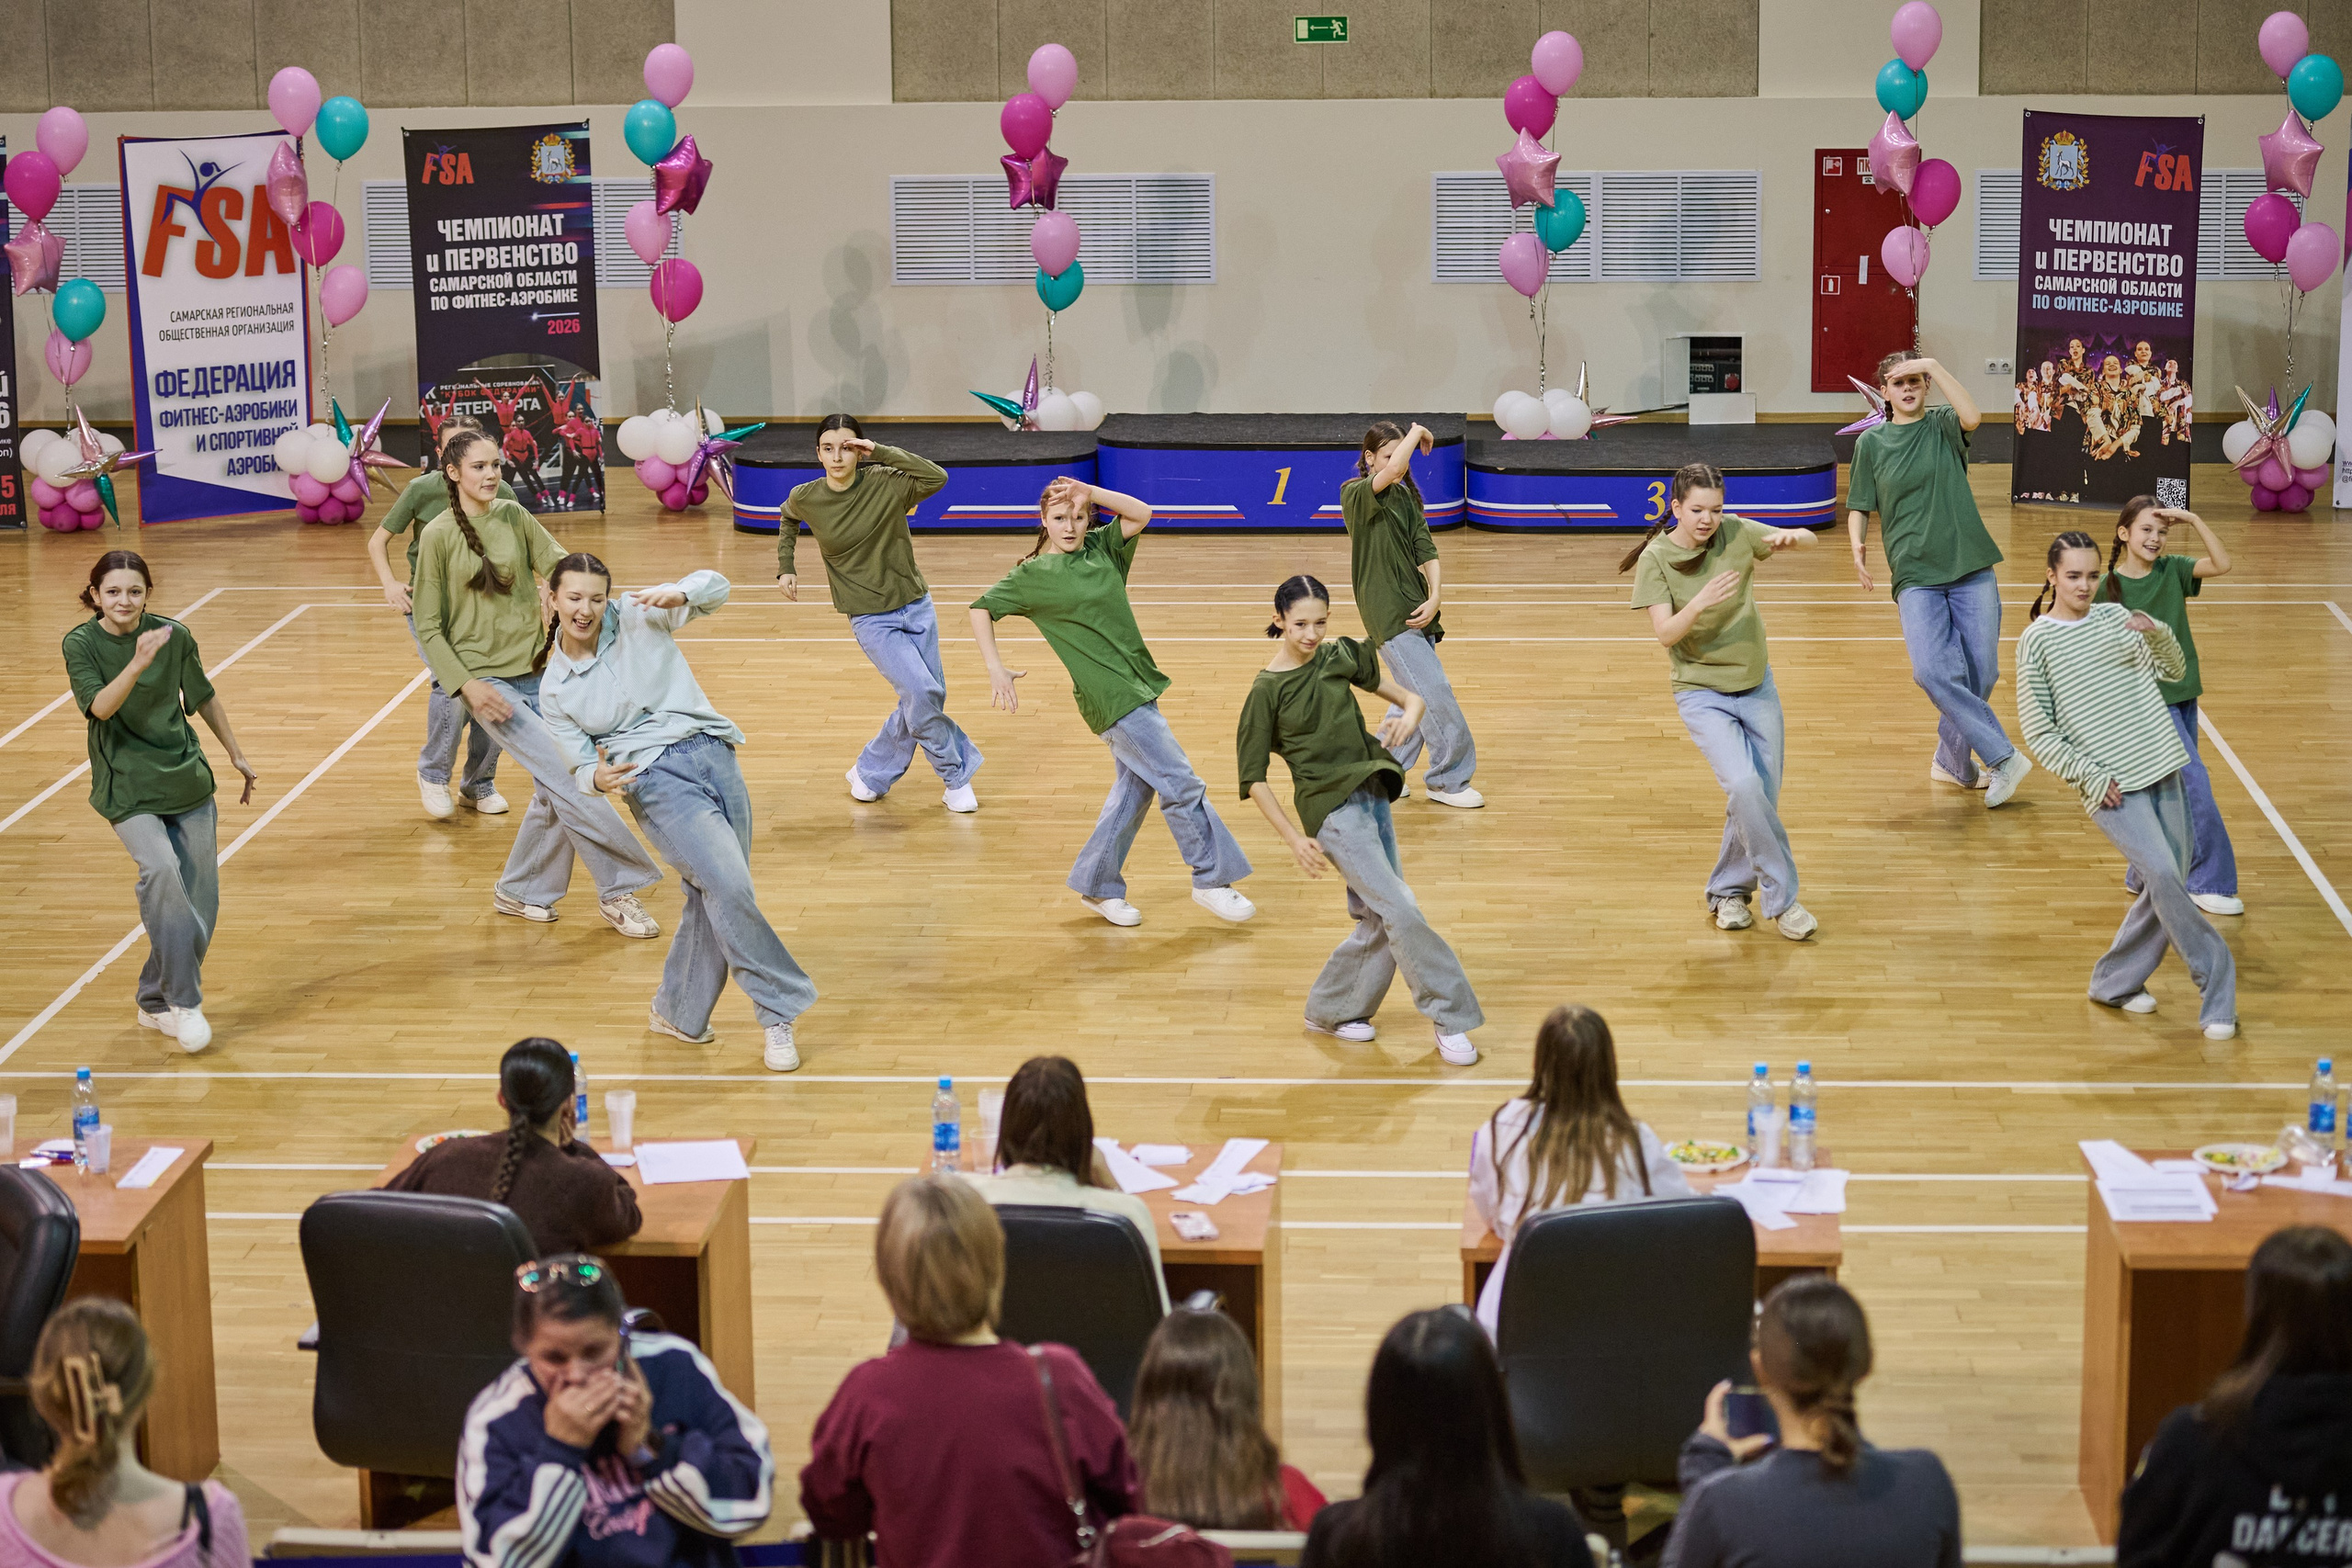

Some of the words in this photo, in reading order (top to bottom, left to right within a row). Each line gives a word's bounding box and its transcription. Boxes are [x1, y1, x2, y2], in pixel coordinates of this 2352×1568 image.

[422, 152, 474, 185] FSA
[2134, 151, 2193, 191] FSA
[141, 185, 296, 279] FSA
[437, 213, 564, 242] ЧЕМПИОНАТ
[2049, 219, 2172, 246] ЧЕМПИОНАТ
[445, 242, 578, 271] ПЕРВЕНСТВО
[2053, 248, 2183, 276] ПЕРВЕНСТВО
[429, 272, 513, 292] САМАРСКОЙ
[516, 270, 578, 288] ОБЛАСТИ
[2034, 275, 2117, 294] САМАРСКОЙ
[2121, 279, 2183, 298] ОБЛАСТИ
[170, 308, 223, 322] САМАРСКАЯ
[226, 302, 294, 319] РЕГИОНАЛЬНАЯ
[431, 296, 448, 310] ПО
[452, 288, 578, 309] ФИТНЕС-АЭРОБИКЕ
[2032, 294, 2050, 310] ПО
[2053, 296, 2183, 317] ФИТНЕС-АЭРОБИКЕ
[159, 325, 230, 342] ОБЩЕСТВЕННАЯ
[232, 320, 294, 336] ОРГАНИЗАЦИЯ
[548, 319, 581, 334] 2026
[154, 359, 296, 399] ФЕДЕРАЦИЯ
[159, 399, 298, 428] ФИТНЕС-АЭРОБИКИ
[197, 434, 206, 452] И
[1267, 467, 1292, 504] 1
[1644, 481, 1666, 521] 3
